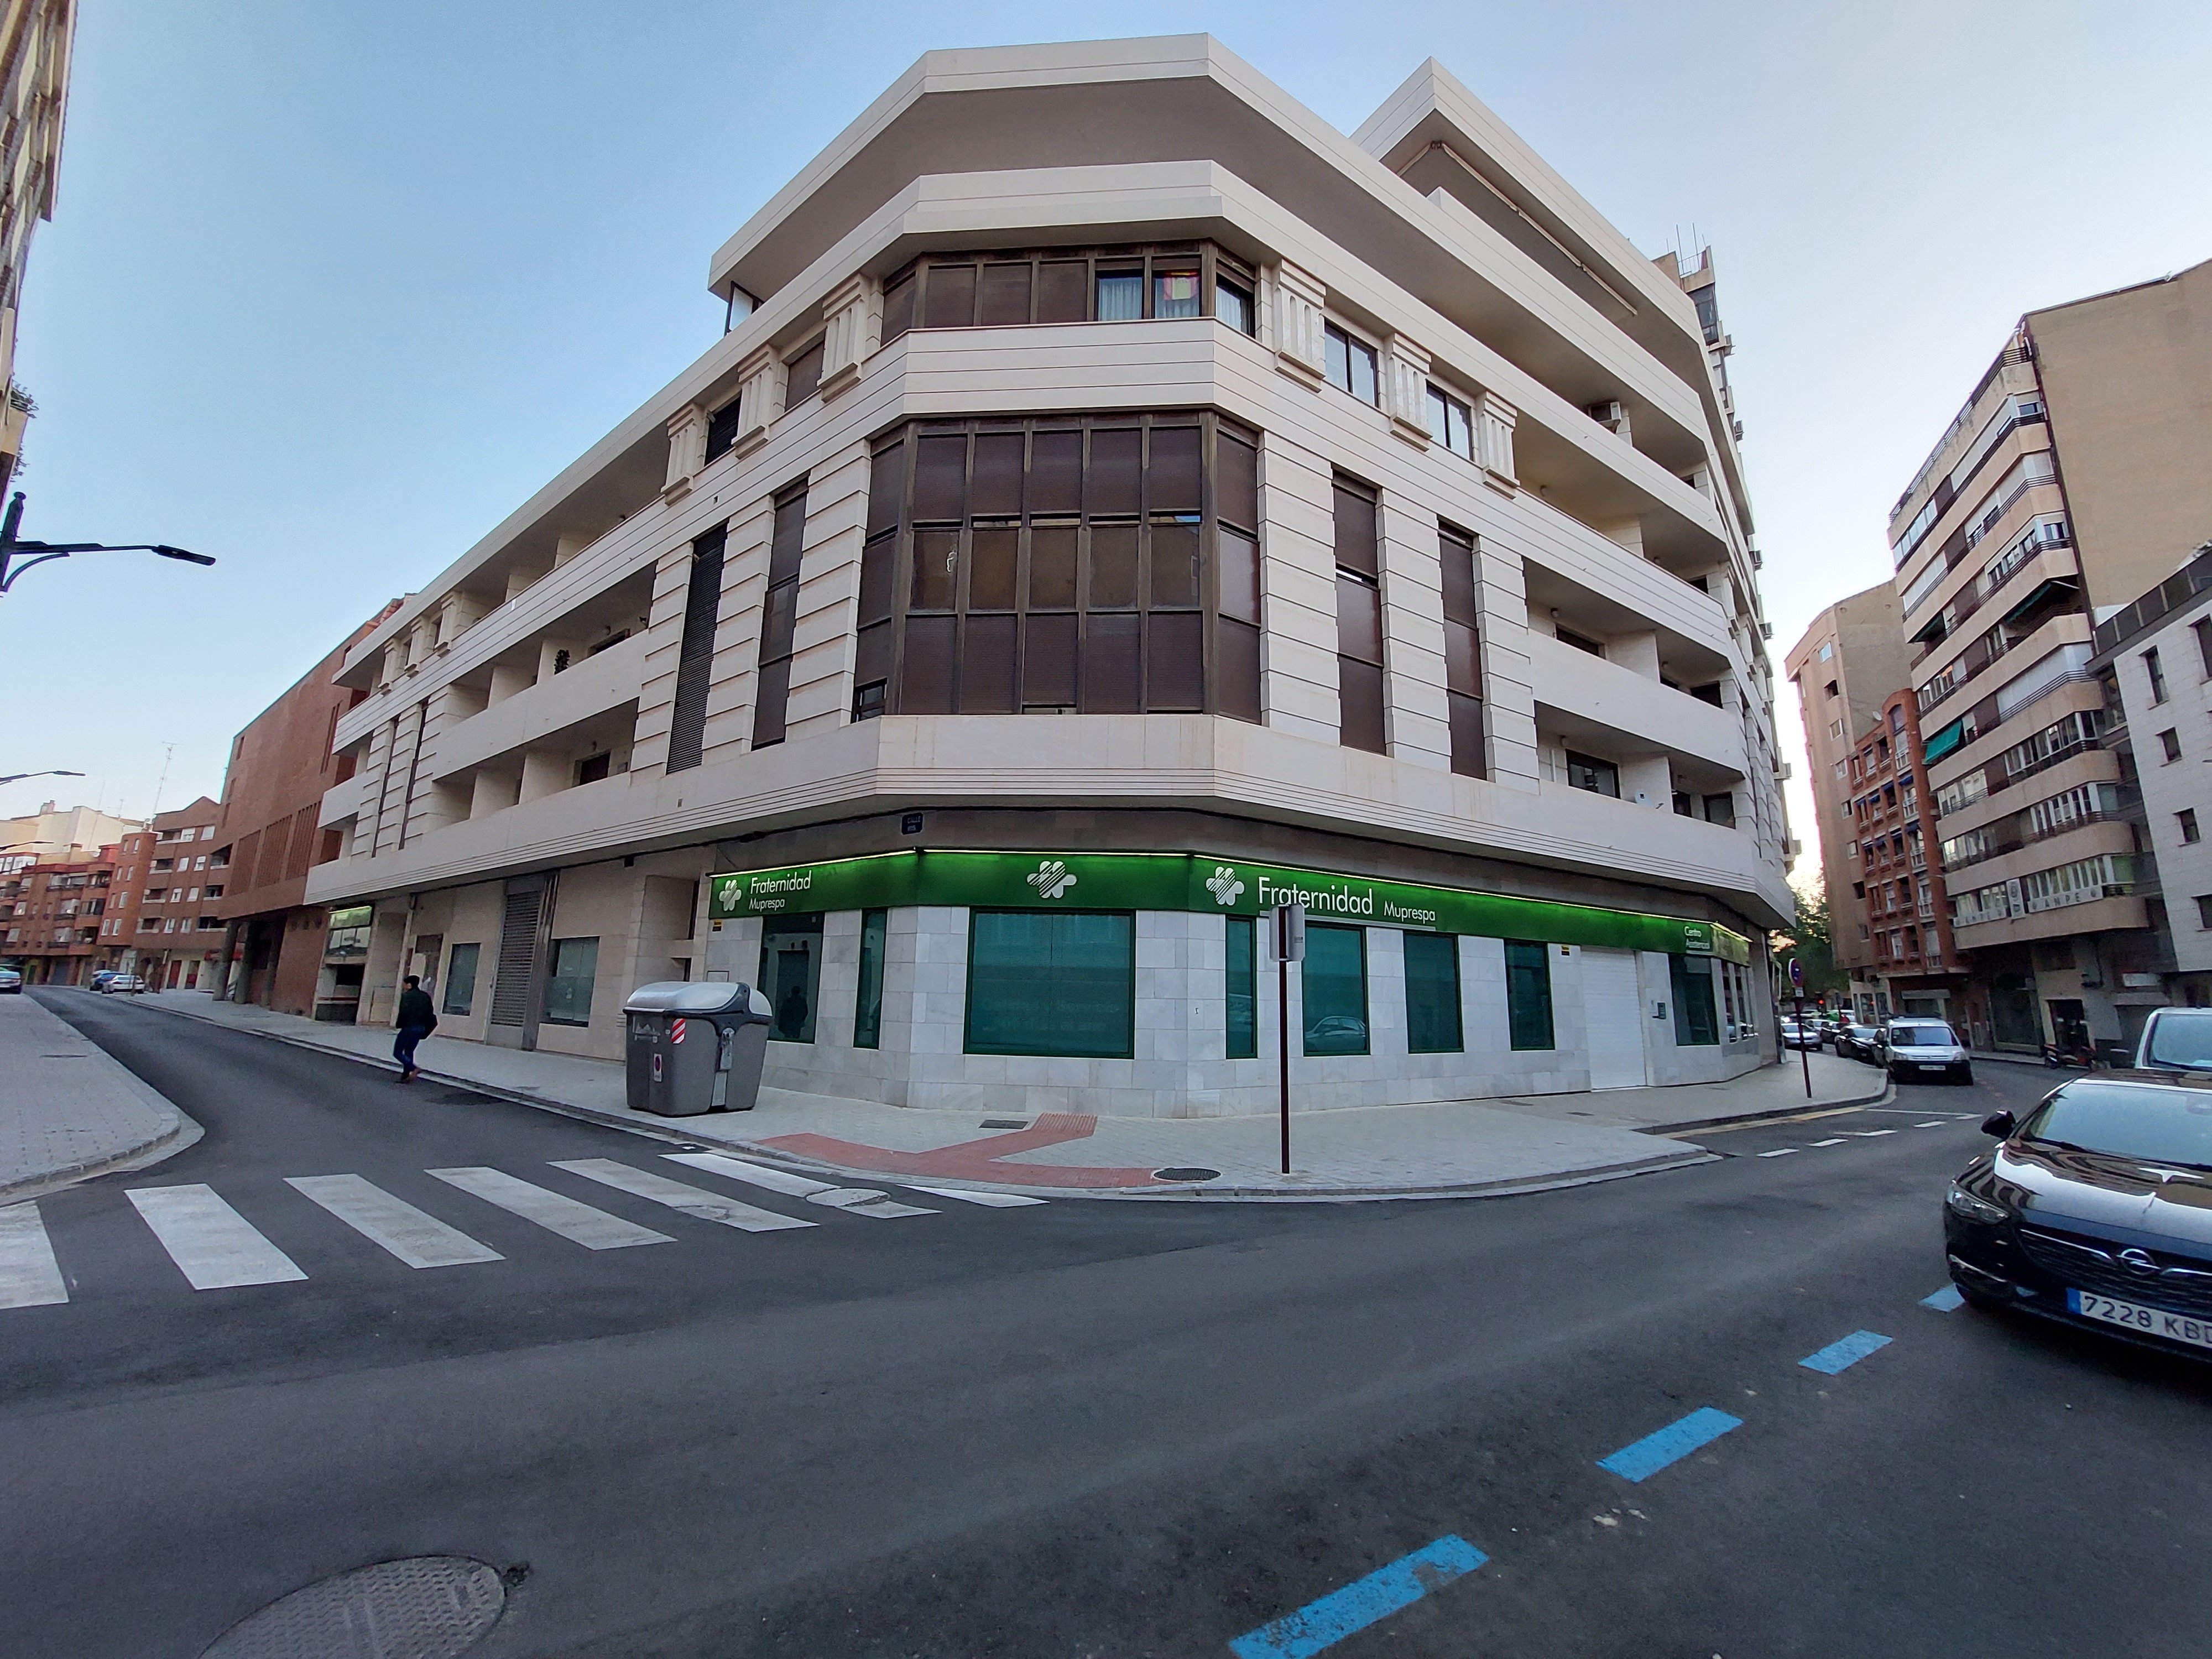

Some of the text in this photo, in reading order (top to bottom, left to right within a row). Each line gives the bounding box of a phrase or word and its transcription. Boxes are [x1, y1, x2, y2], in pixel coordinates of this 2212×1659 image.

[750, 870, 811, 894] Fraternidad
[749, 898, 785, 912] Muprespa
[1259, 877, 1436, 924] Fraternidad Muprespa
[2044, 892, 2081, 907] ANPE
[1684, 926, 1702, 937] Centro
[2084, 1296, 2152, 1328] 7228
